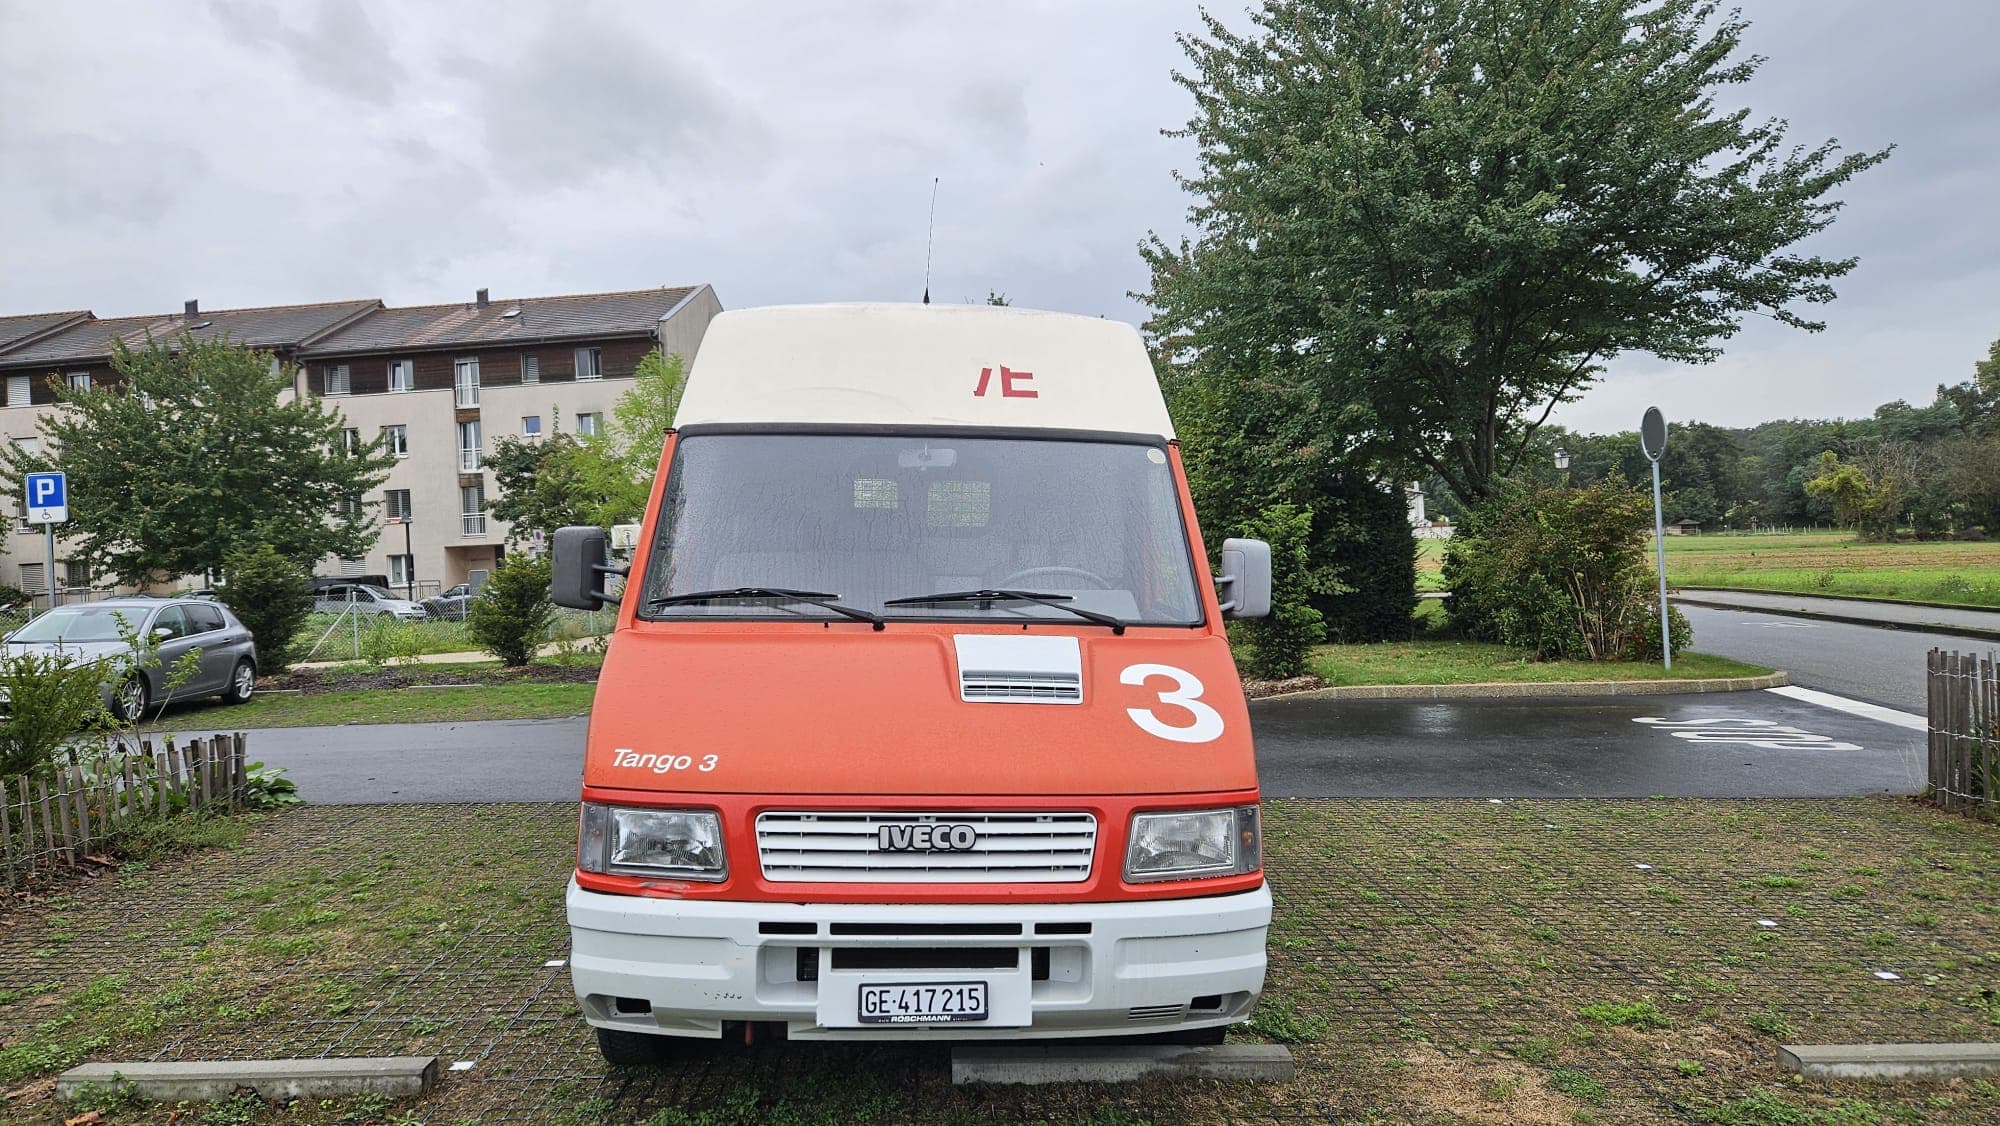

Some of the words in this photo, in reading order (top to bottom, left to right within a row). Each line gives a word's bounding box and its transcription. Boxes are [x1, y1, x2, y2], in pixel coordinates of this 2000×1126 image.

[36, 478, 55, 505] P
[1119, 663, 1225, 743] 3
[613, 748, 692, 774] Tango
[698, 754, 719, 772] 3
[879, 825, 976, 850] IVECO
